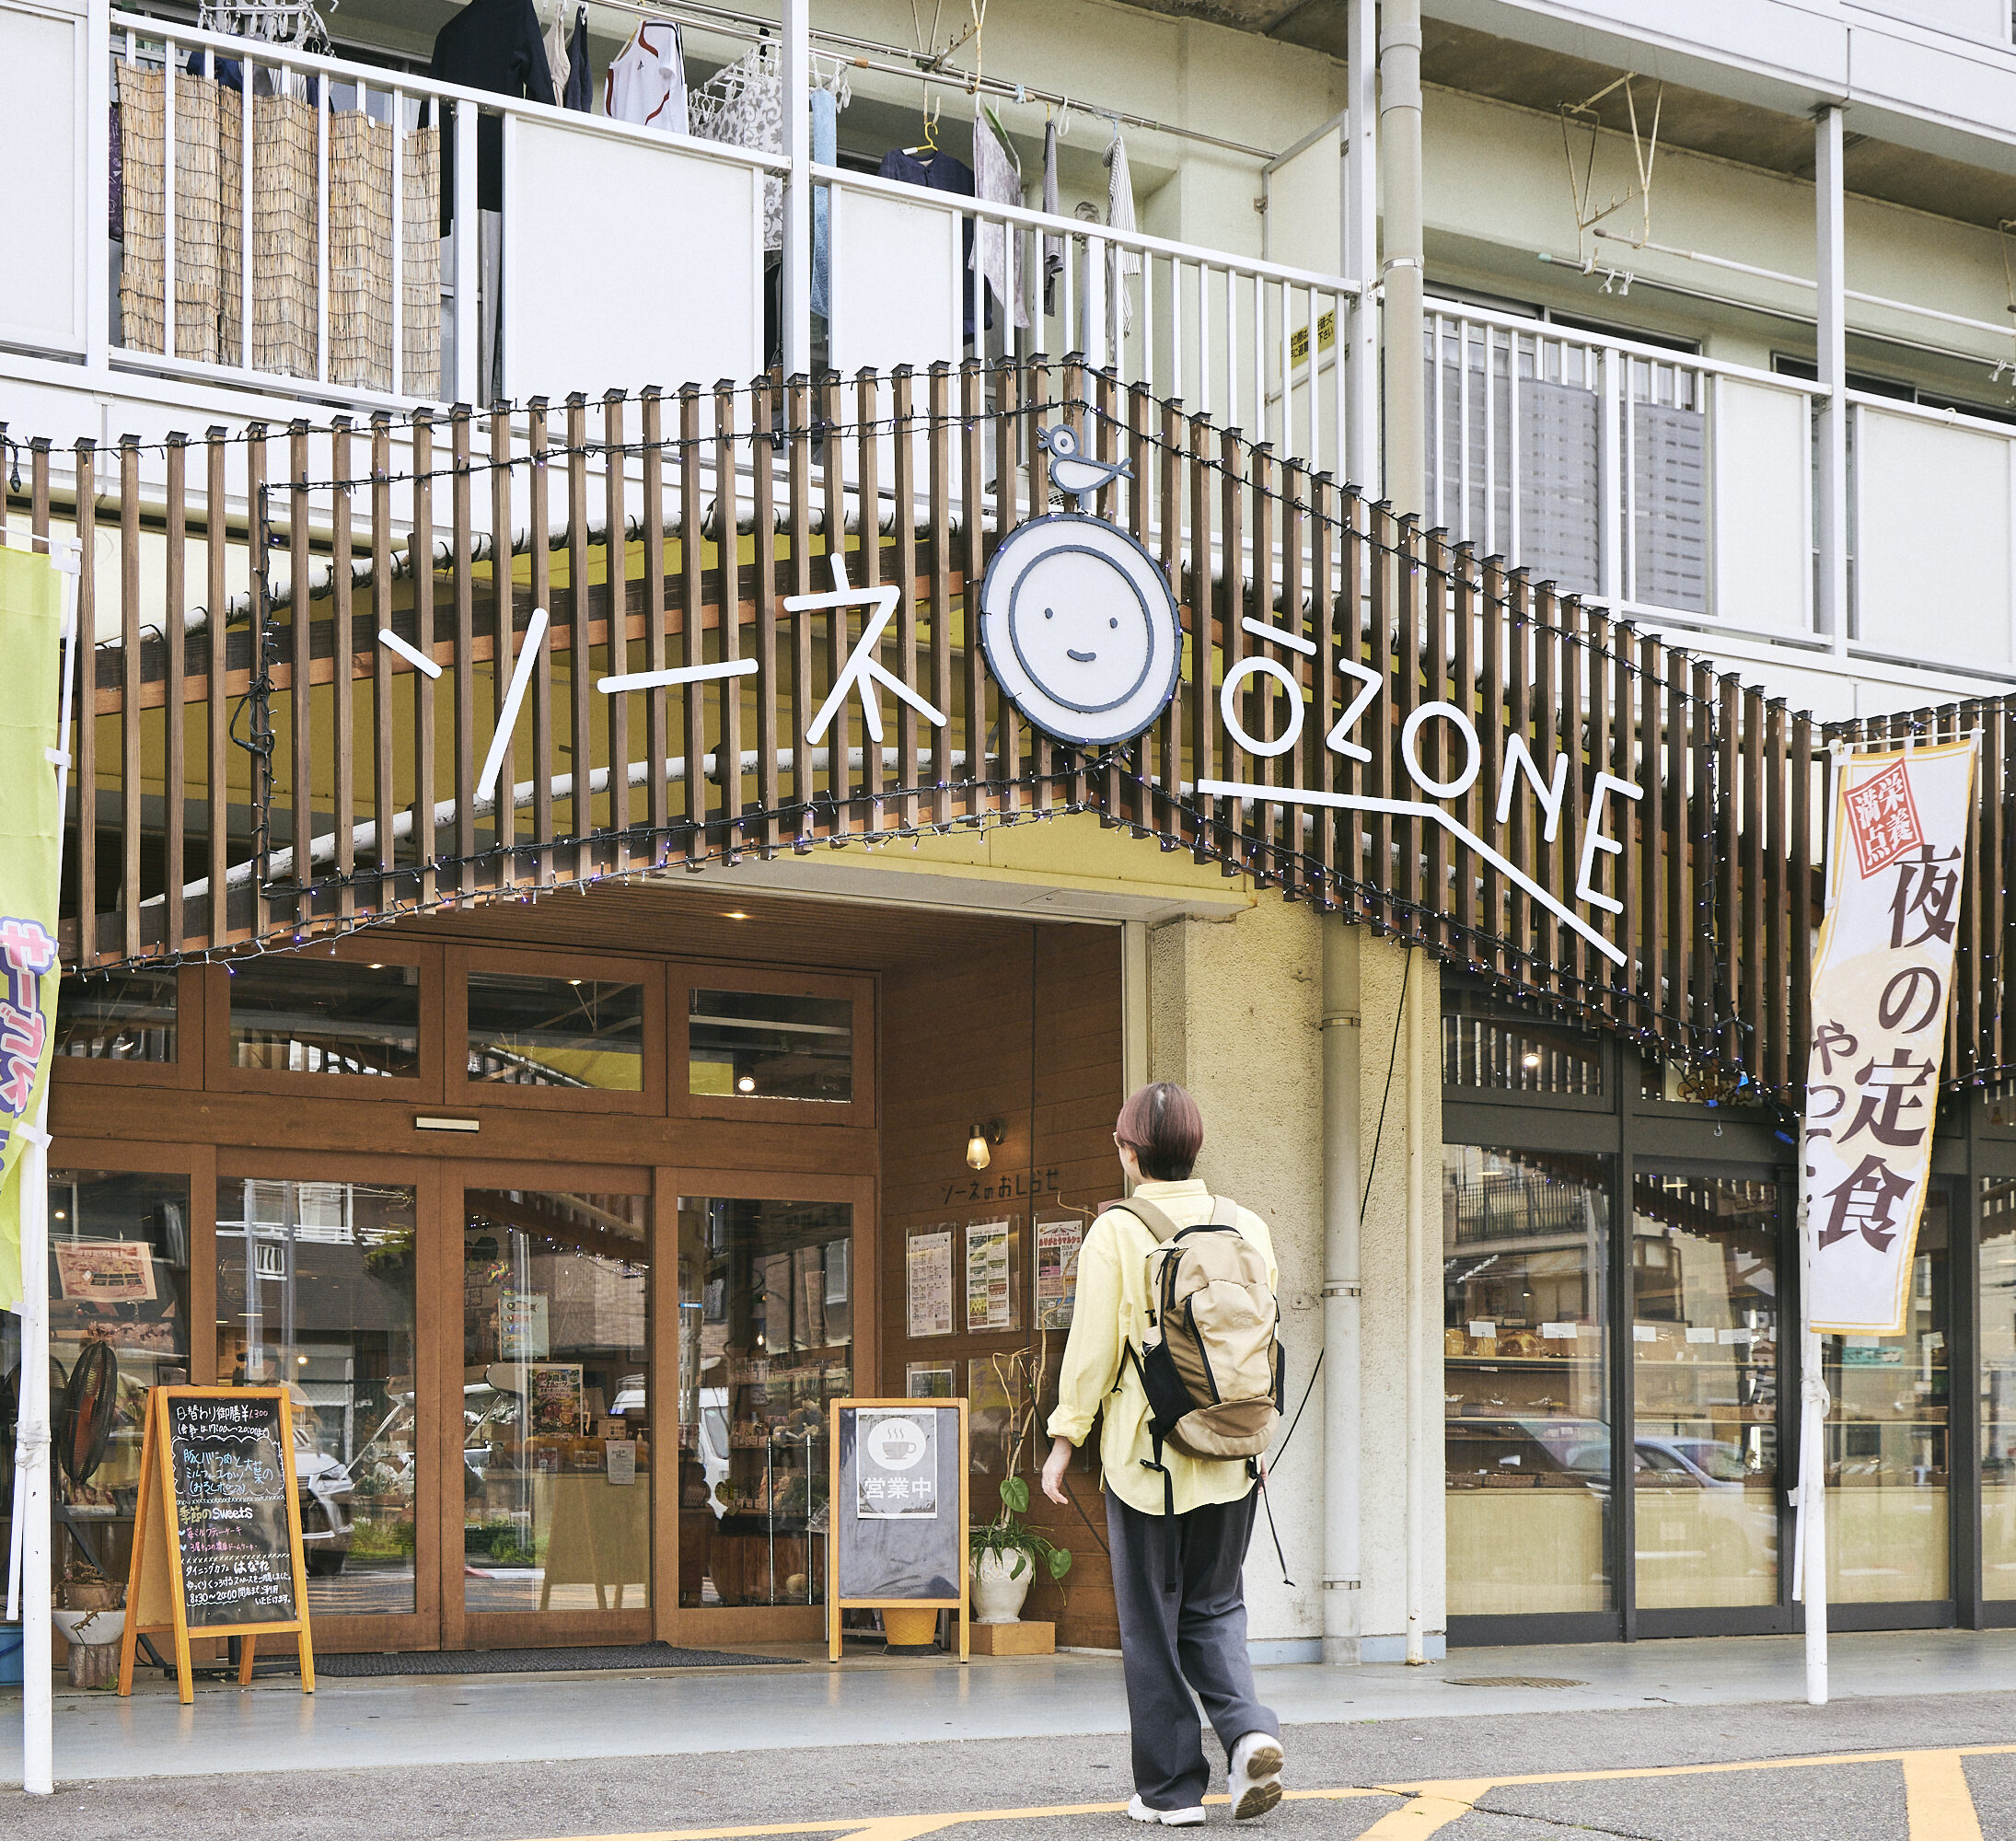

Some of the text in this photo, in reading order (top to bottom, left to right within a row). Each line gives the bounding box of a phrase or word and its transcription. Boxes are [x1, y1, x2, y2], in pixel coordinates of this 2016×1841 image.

[378, 553, 946, 801] ソーネ
[1817, 844, 1963, 1253] 夜の定食
[942, 1168, 1059, 1205] ソーネのおしらせ
[864, 1476, 932, 1499] 営業中
